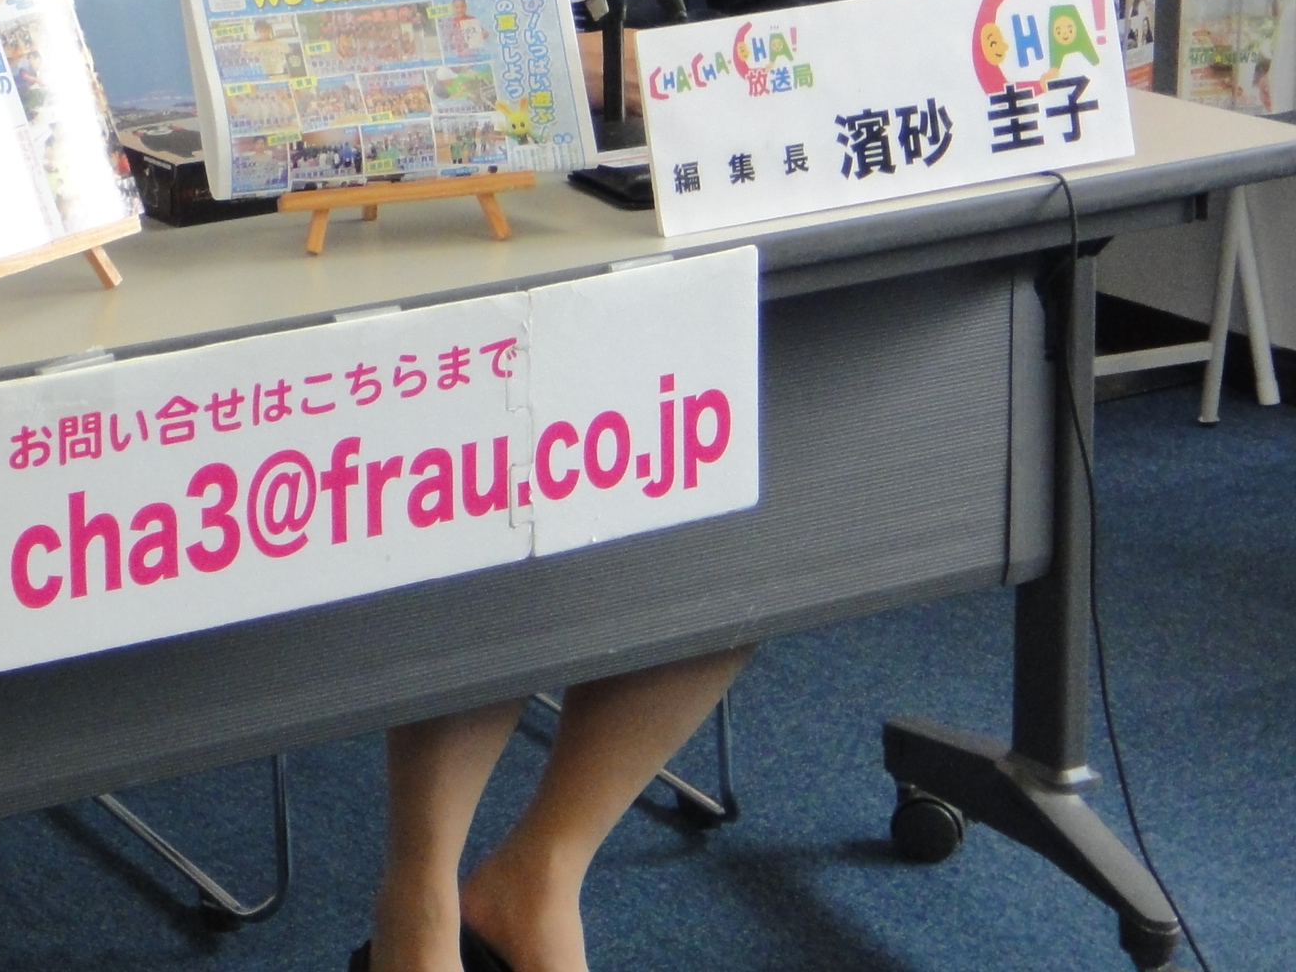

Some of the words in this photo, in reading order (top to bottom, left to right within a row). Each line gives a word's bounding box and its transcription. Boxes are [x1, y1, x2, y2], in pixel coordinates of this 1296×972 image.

[747, 63, 814, 98] 放送局
[834, 98, 954, 180] 濱砂
[987, 74, 1099, 154] 圭子
[7, 337, 519, 470] お問い合せはこちらまで
[10, 372, 733, 610] cha3@frau.co.jp
